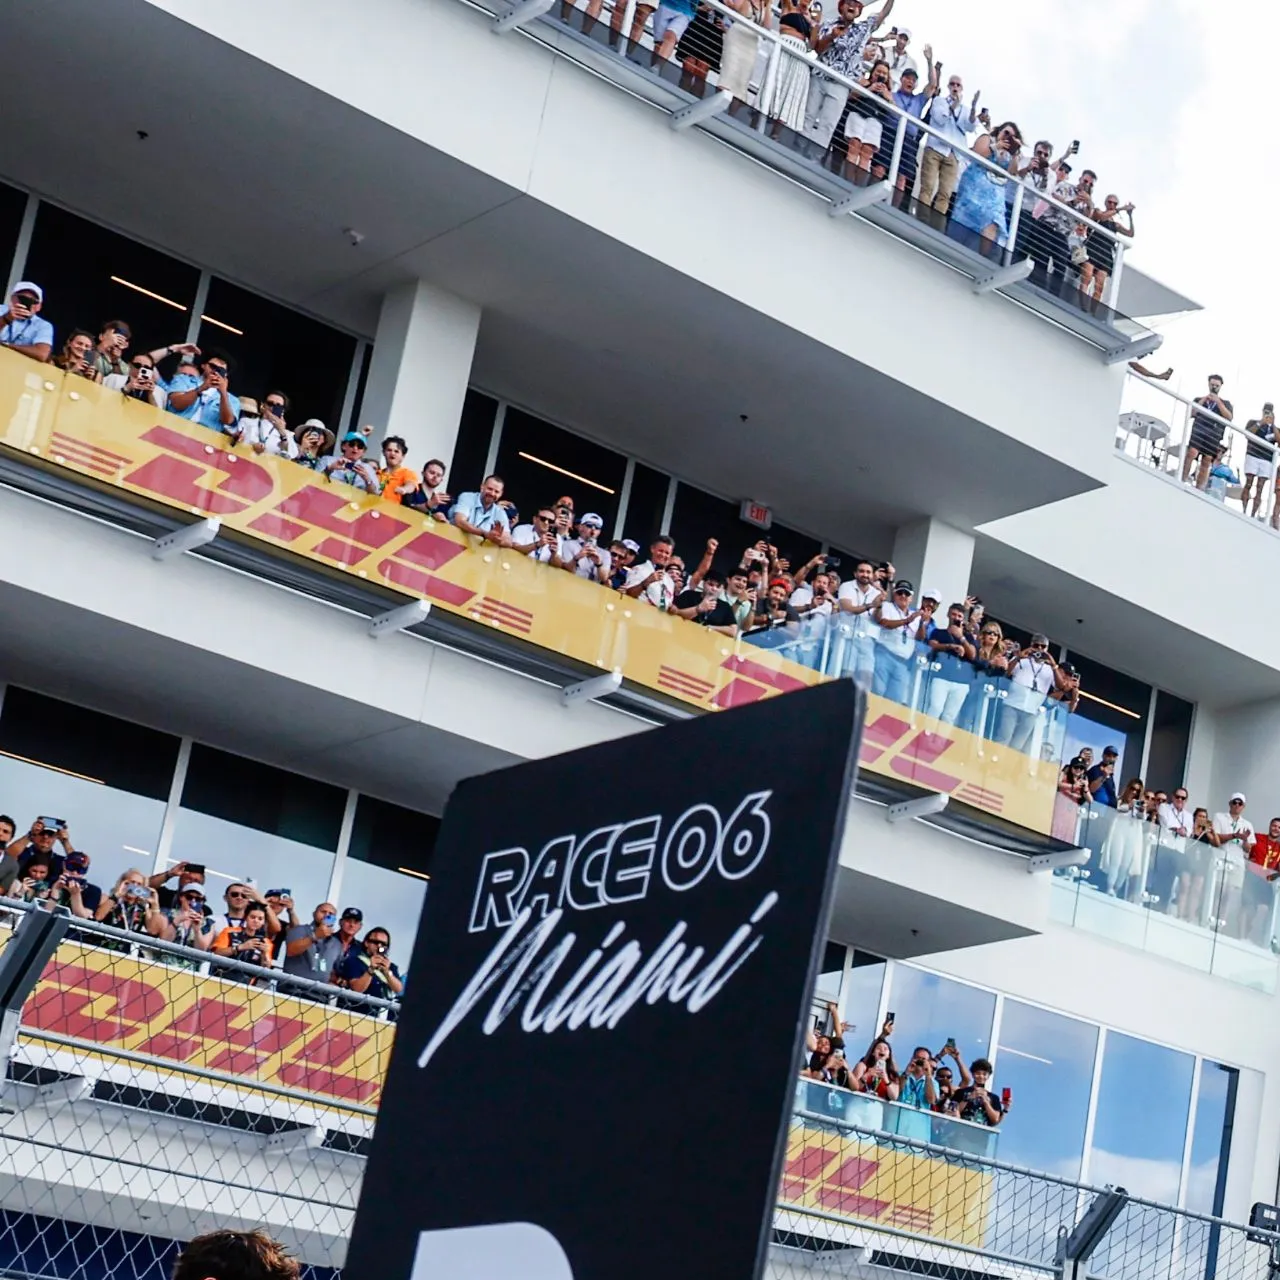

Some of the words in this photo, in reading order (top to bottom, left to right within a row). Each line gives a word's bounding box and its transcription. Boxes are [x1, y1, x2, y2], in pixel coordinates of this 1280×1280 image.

[123, 425, 477, 606] DHL
[21, 961, 381, 1101] DHL
[418, 892, 778, 1068] Miami
